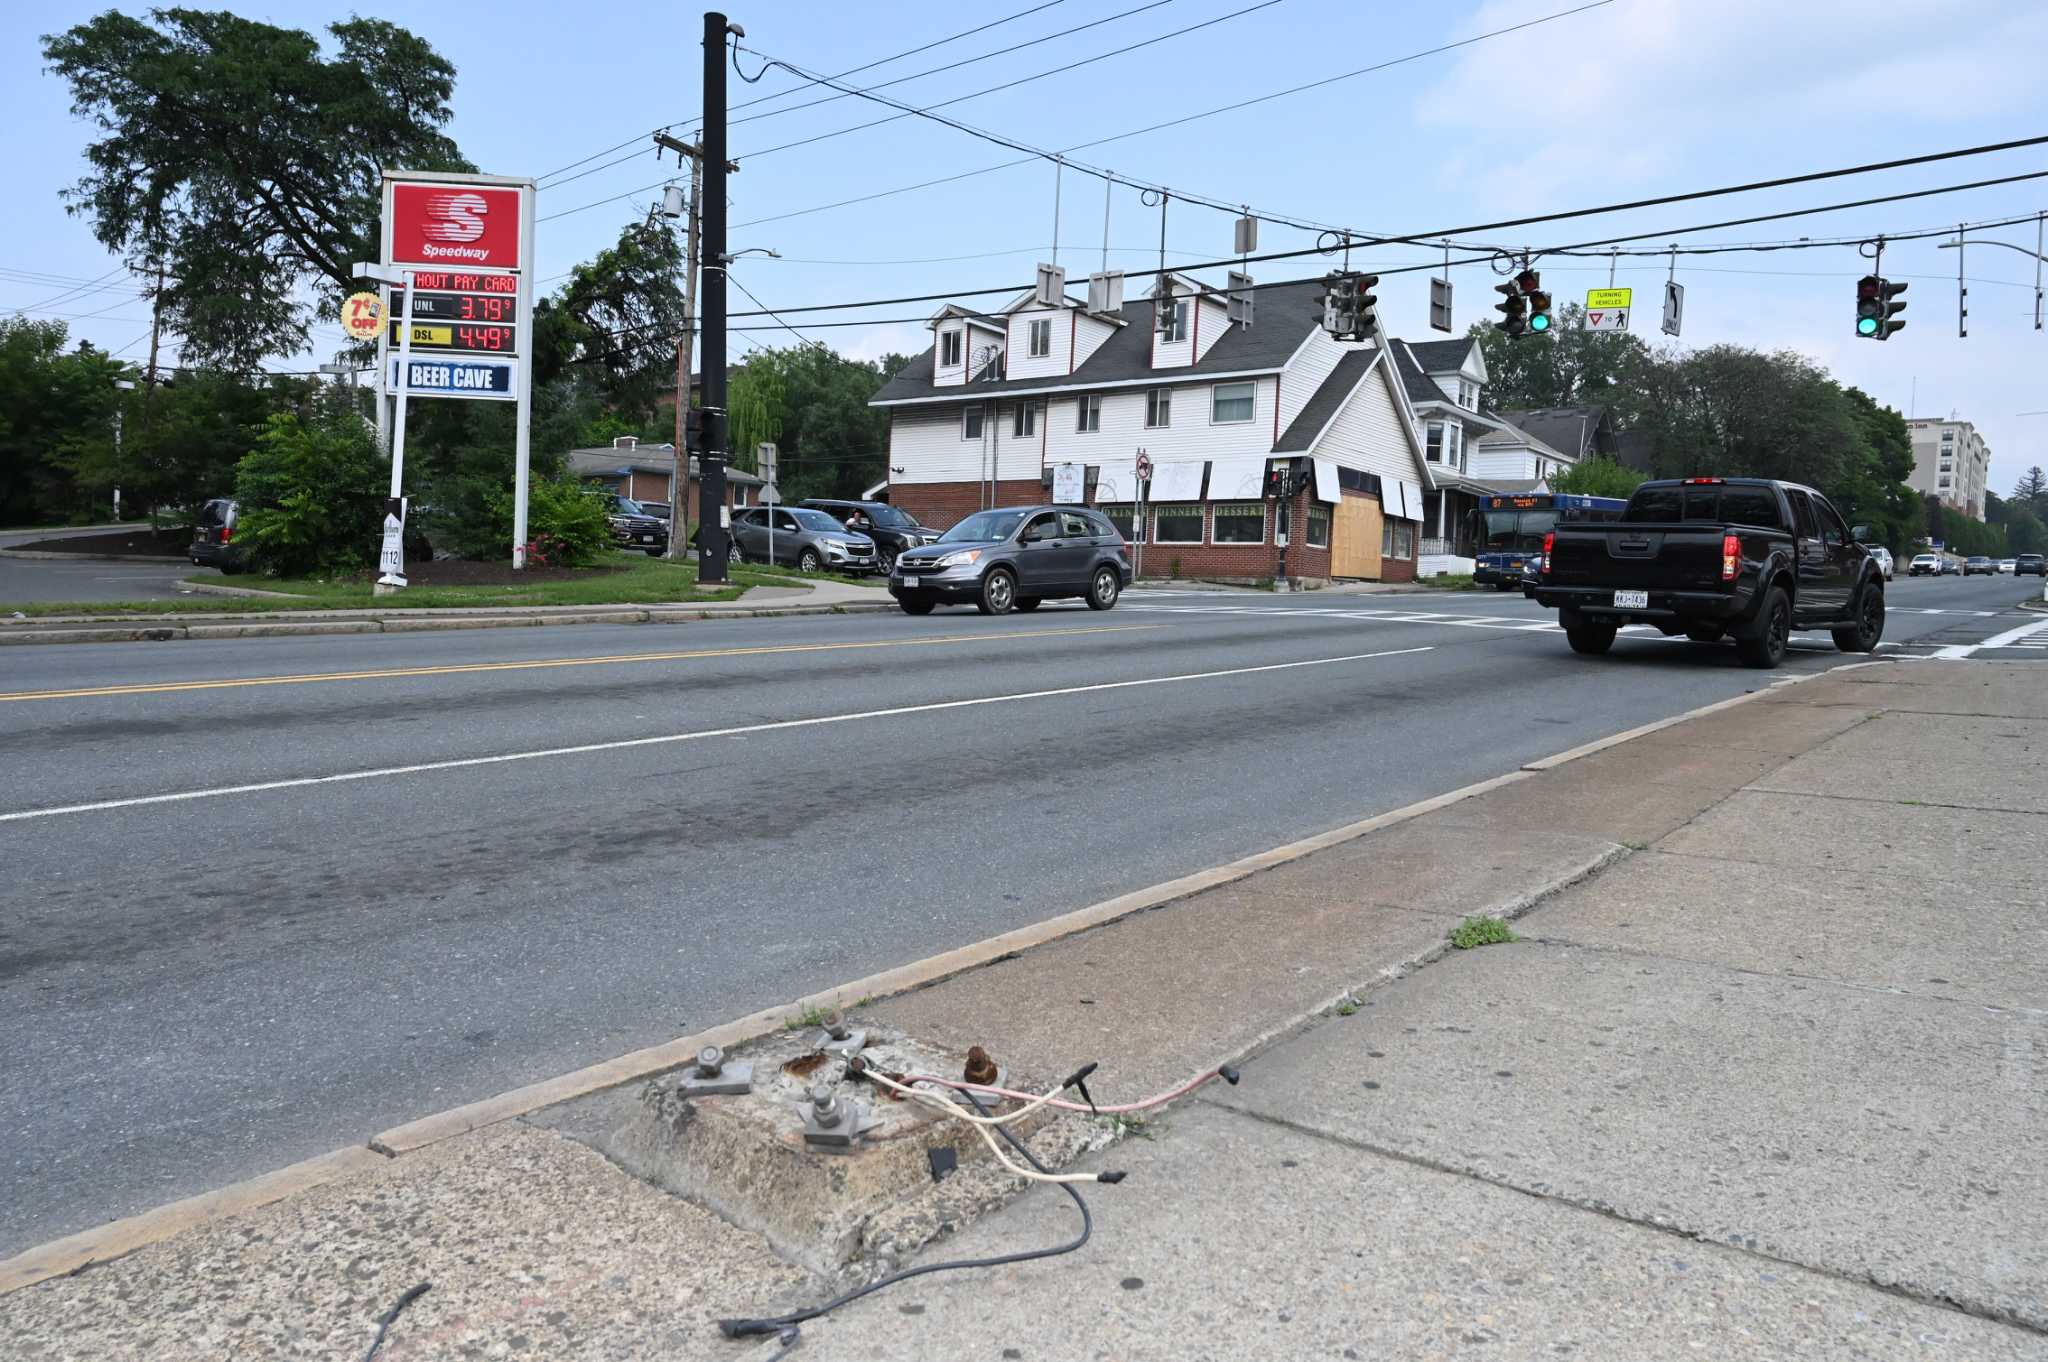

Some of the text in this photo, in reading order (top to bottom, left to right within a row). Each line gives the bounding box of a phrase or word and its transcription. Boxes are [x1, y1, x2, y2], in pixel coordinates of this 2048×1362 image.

[422, 244, 489, 260] Speedway
[454, 274, 480, 290] PAY
[484, 275, 515, 291] CARD
[414, 299, 435, 312] UNL
[351, 318, 378, 330] OFF
[1665, 319, 1678, 330] ONLY
[414, 329, 434, 341] DSL
[411, 365, 493, 389] BEER CAVE
[1158, 507, 1205, 517] DINNERS
